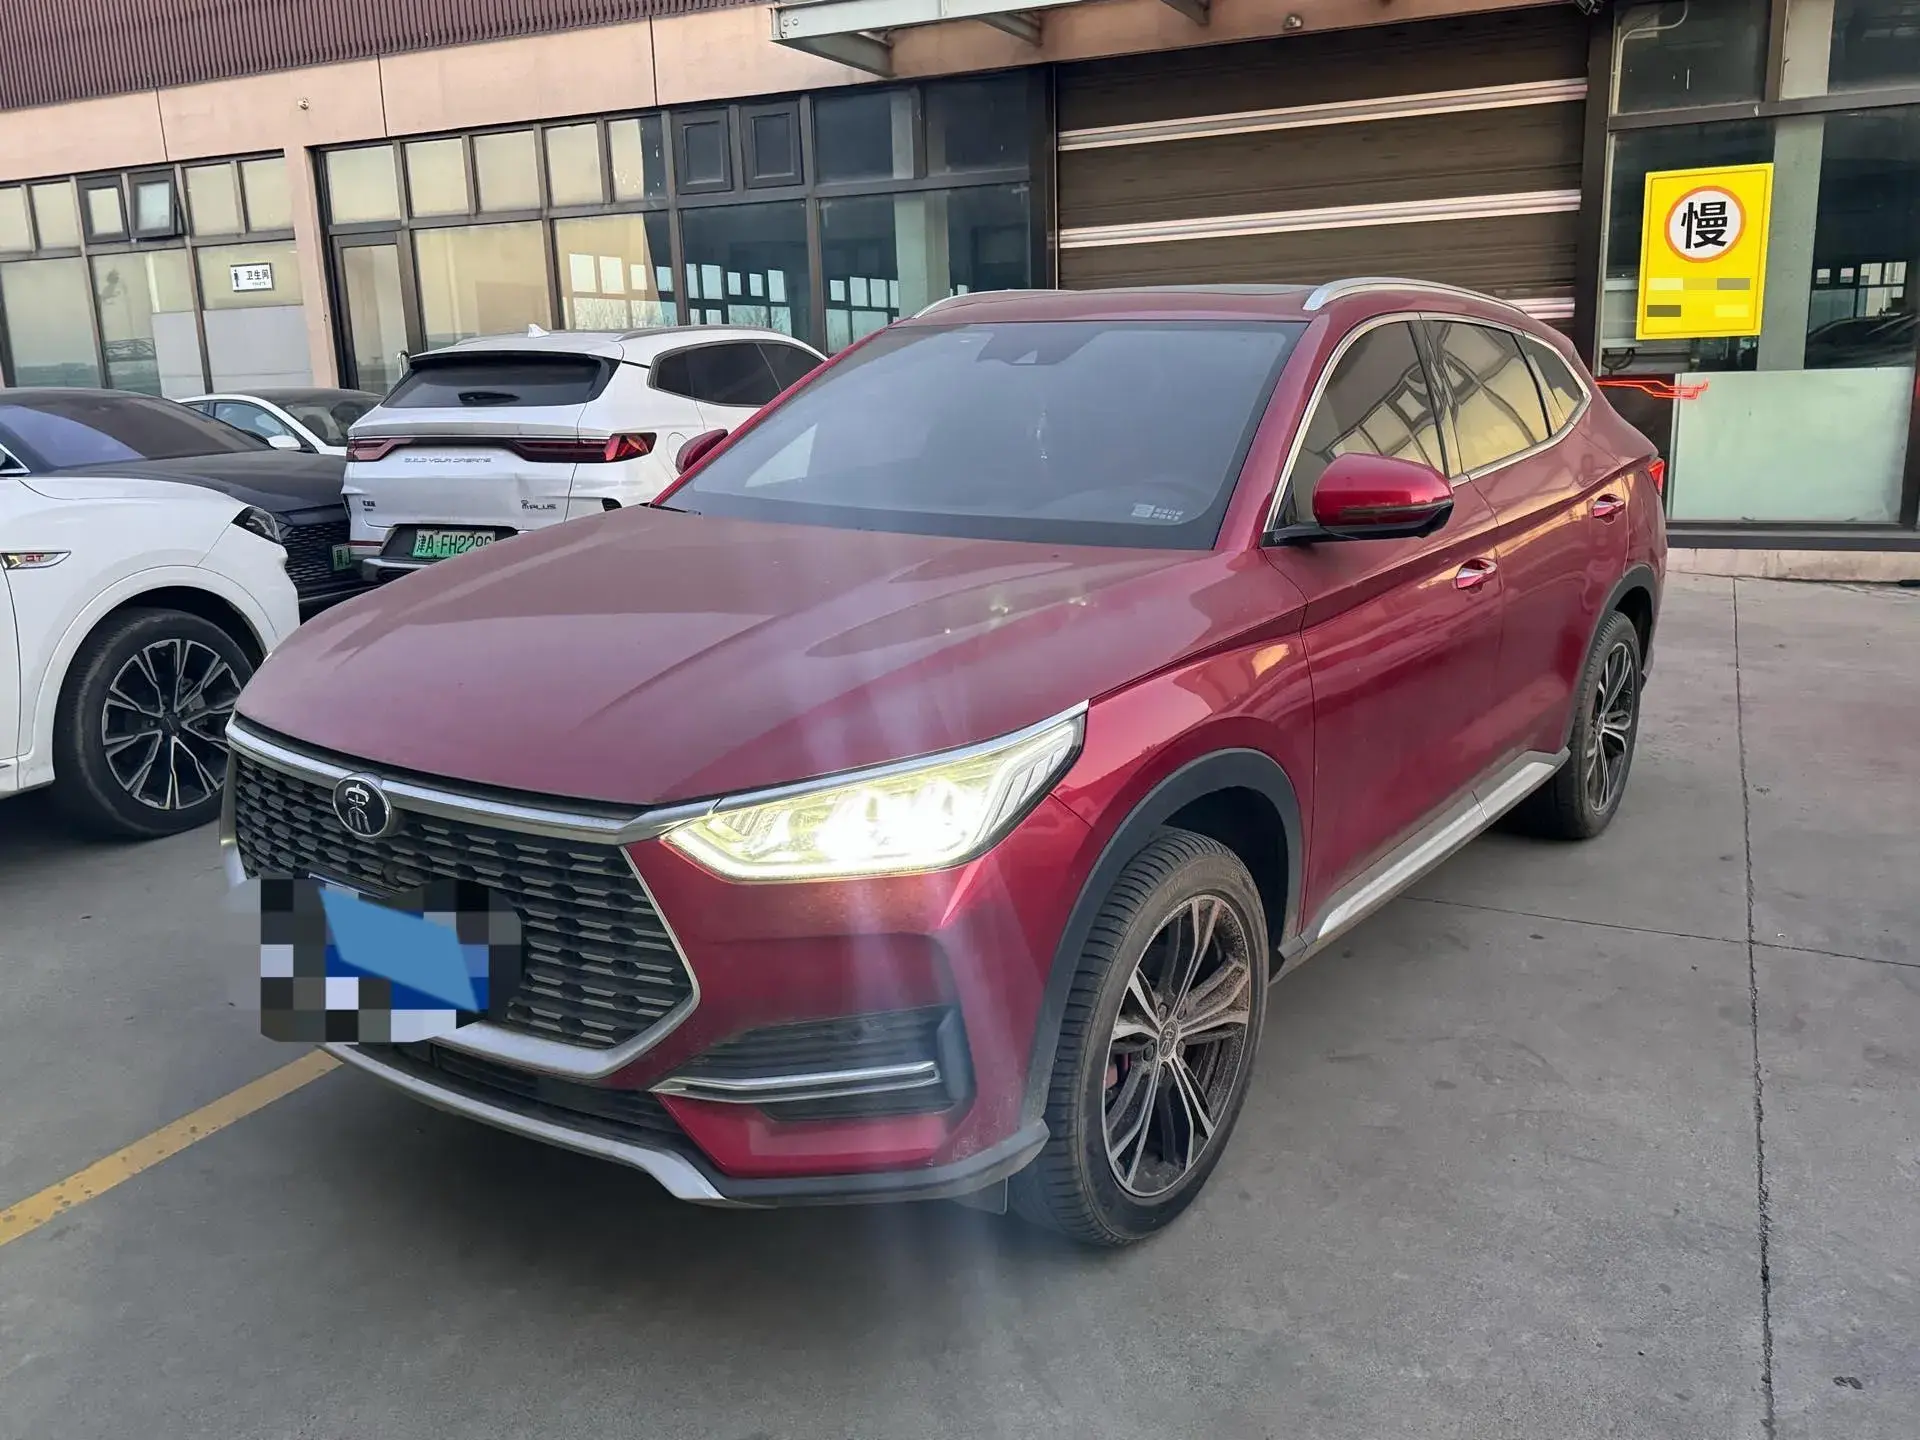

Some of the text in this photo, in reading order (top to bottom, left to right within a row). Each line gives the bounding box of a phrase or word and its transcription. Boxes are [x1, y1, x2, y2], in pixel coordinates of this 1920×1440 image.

[1681, 201, 1728, 249] 慢
[246, 269, 269, 280] 卫生间
